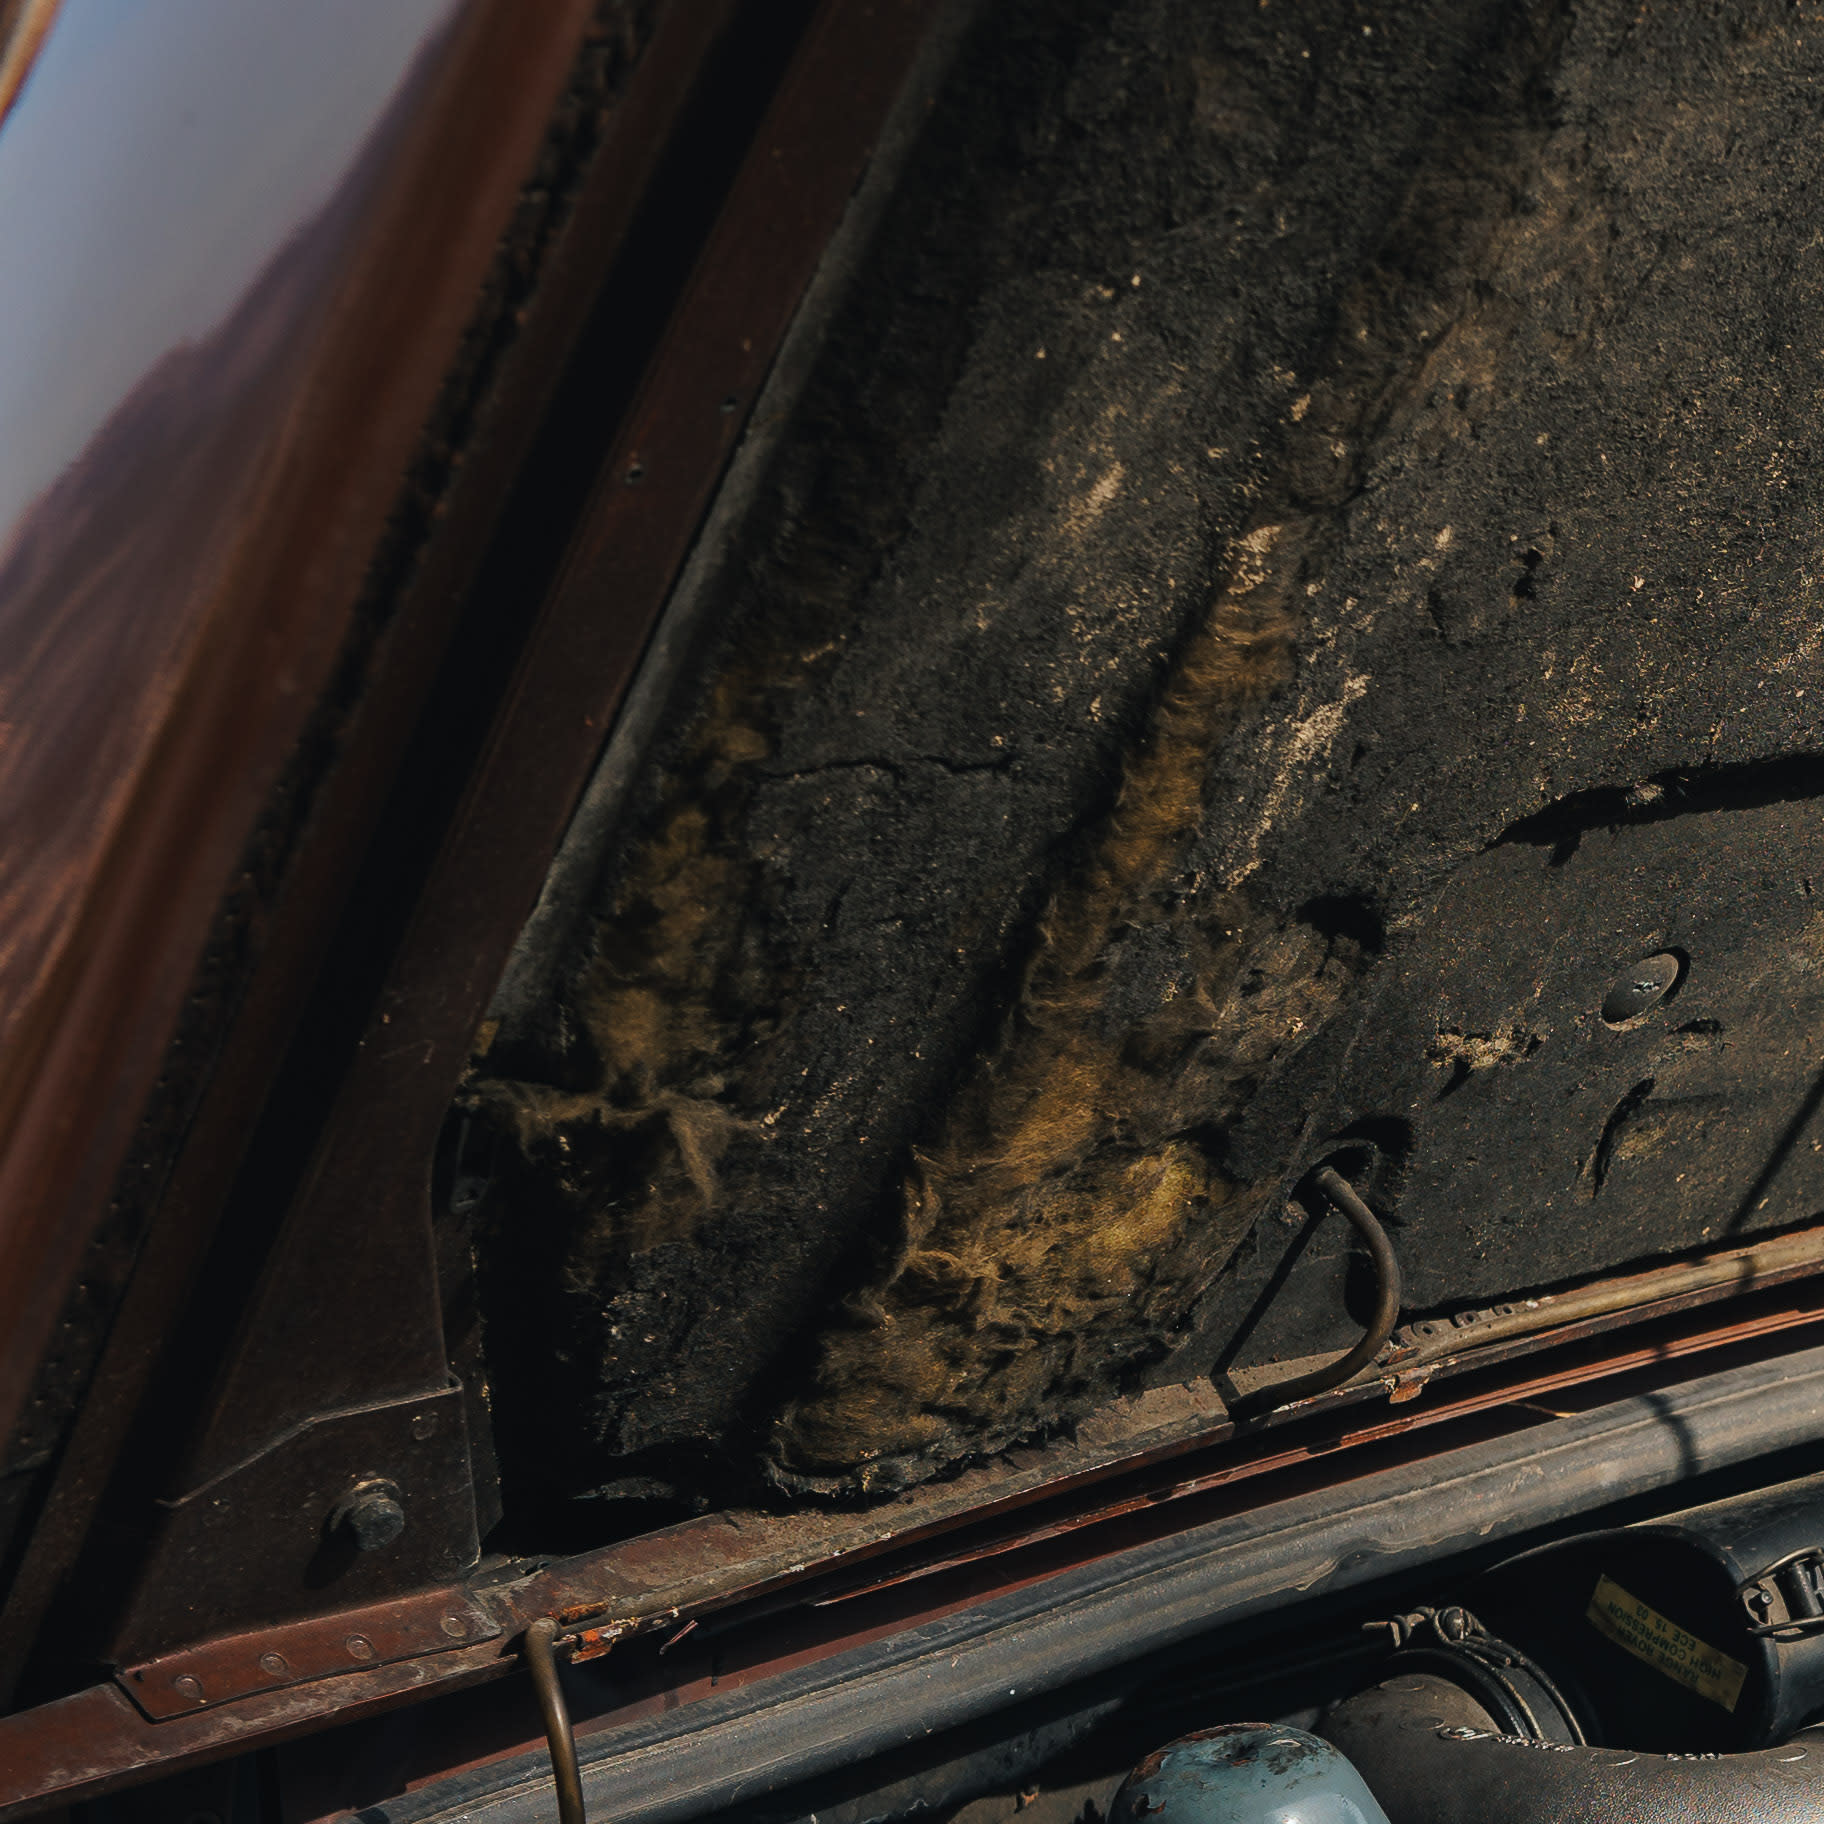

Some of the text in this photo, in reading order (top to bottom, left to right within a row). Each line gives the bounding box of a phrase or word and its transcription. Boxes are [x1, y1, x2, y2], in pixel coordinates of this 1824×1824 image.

[1607, 1601, 1721, 1680] HIGH COMPRESSION
[1672, 1628, 1697, 1652] ECE
[1656, 1652, 1699, 1682] RANGE
